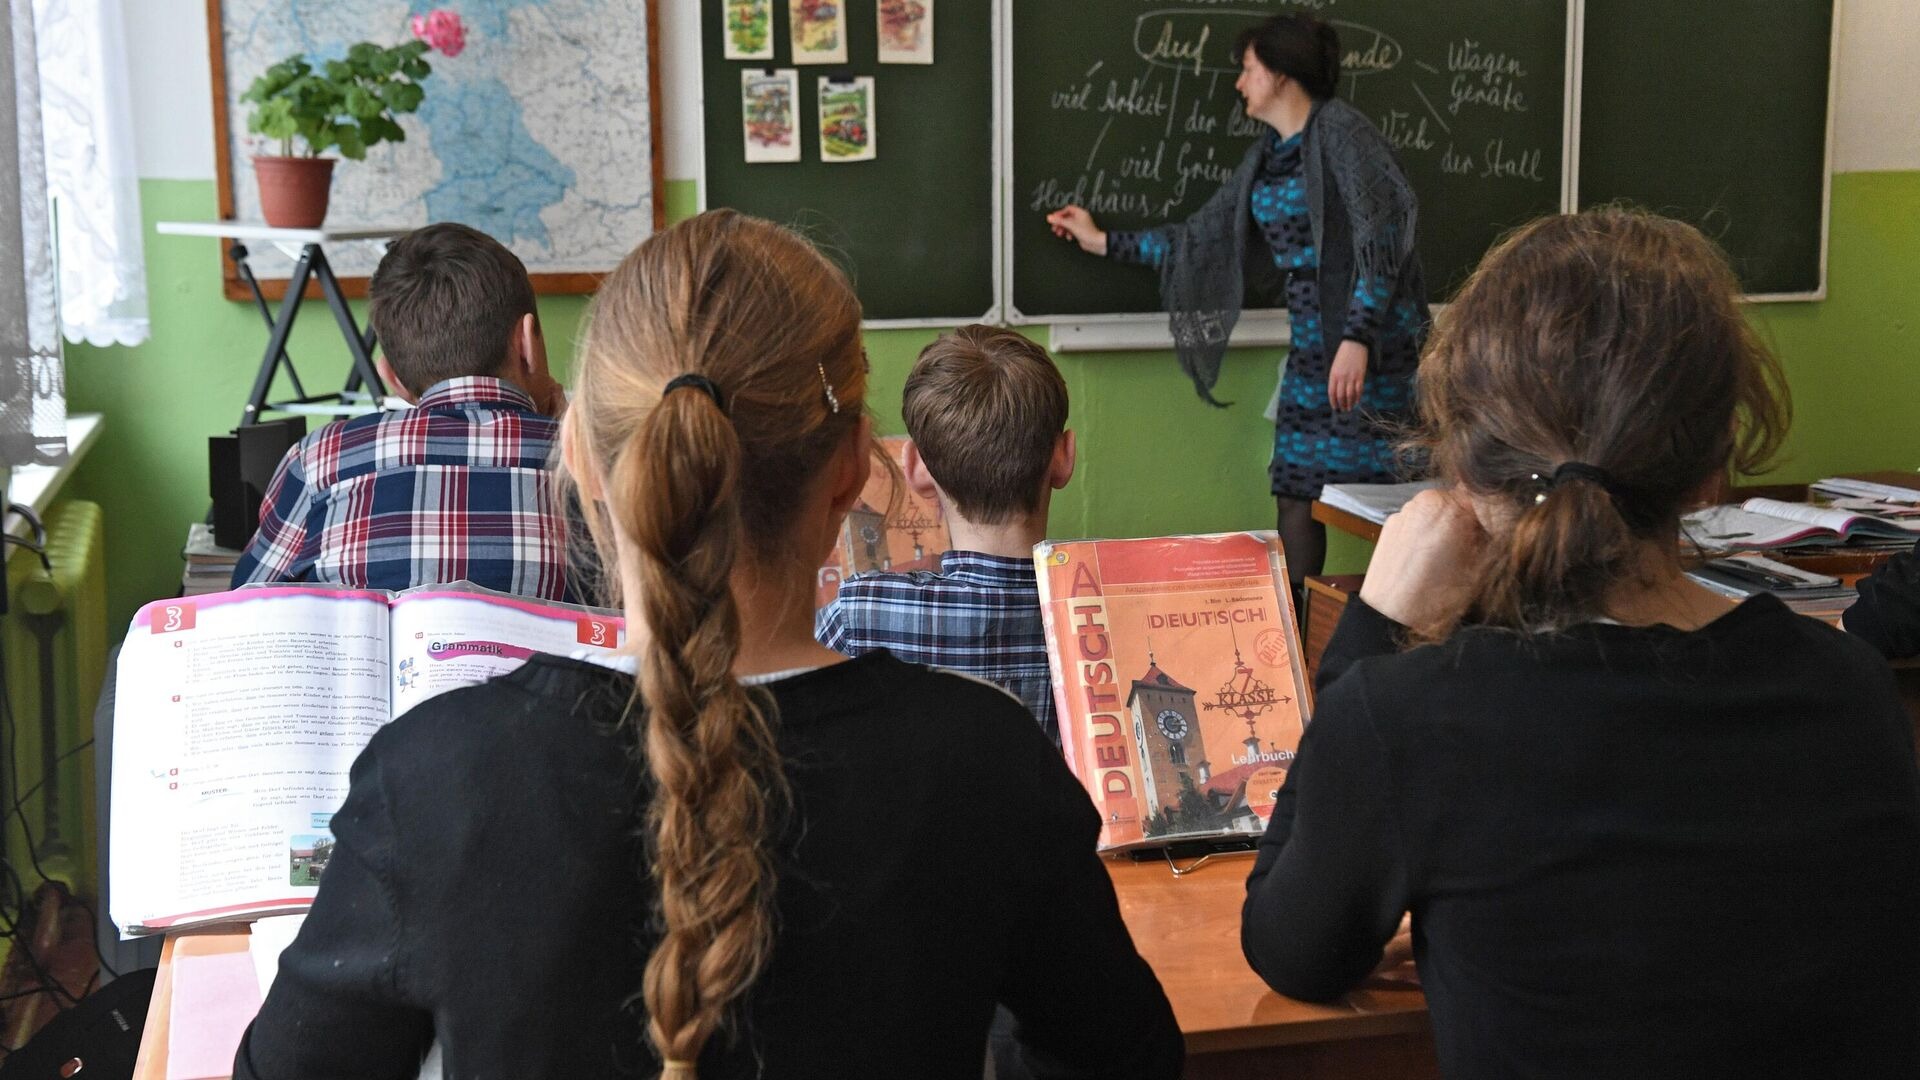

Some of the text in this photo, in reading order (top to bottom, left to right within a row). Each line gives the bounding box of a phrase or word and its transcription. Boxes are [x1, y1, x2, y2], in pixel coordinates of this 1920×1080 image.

[1153, 20, 1393, 76] Auf nde
[1051, 77, 1167, 117] viel Arbeit
[1185, 97, 1268, 137] der Bau
[1120, 140, 1166, 182] viel
[1442, 138, 1544, 182] der Stall
[1030, 169, 1182, 218] Hochhäusr
[1071, 561, 1102, 597] A
[164, 605, 182, 632] 3
[590, 621, 606, 645] 3
[1148, 608, 1266, 629] DEUTSCH
[432, 641, 503, 655] Grammatik
[1216, 688, 1276, 706] KLASSE
[1237, 668, 1254, 694] 7
[1074, 605, 1132, 799] DEUTSCH
